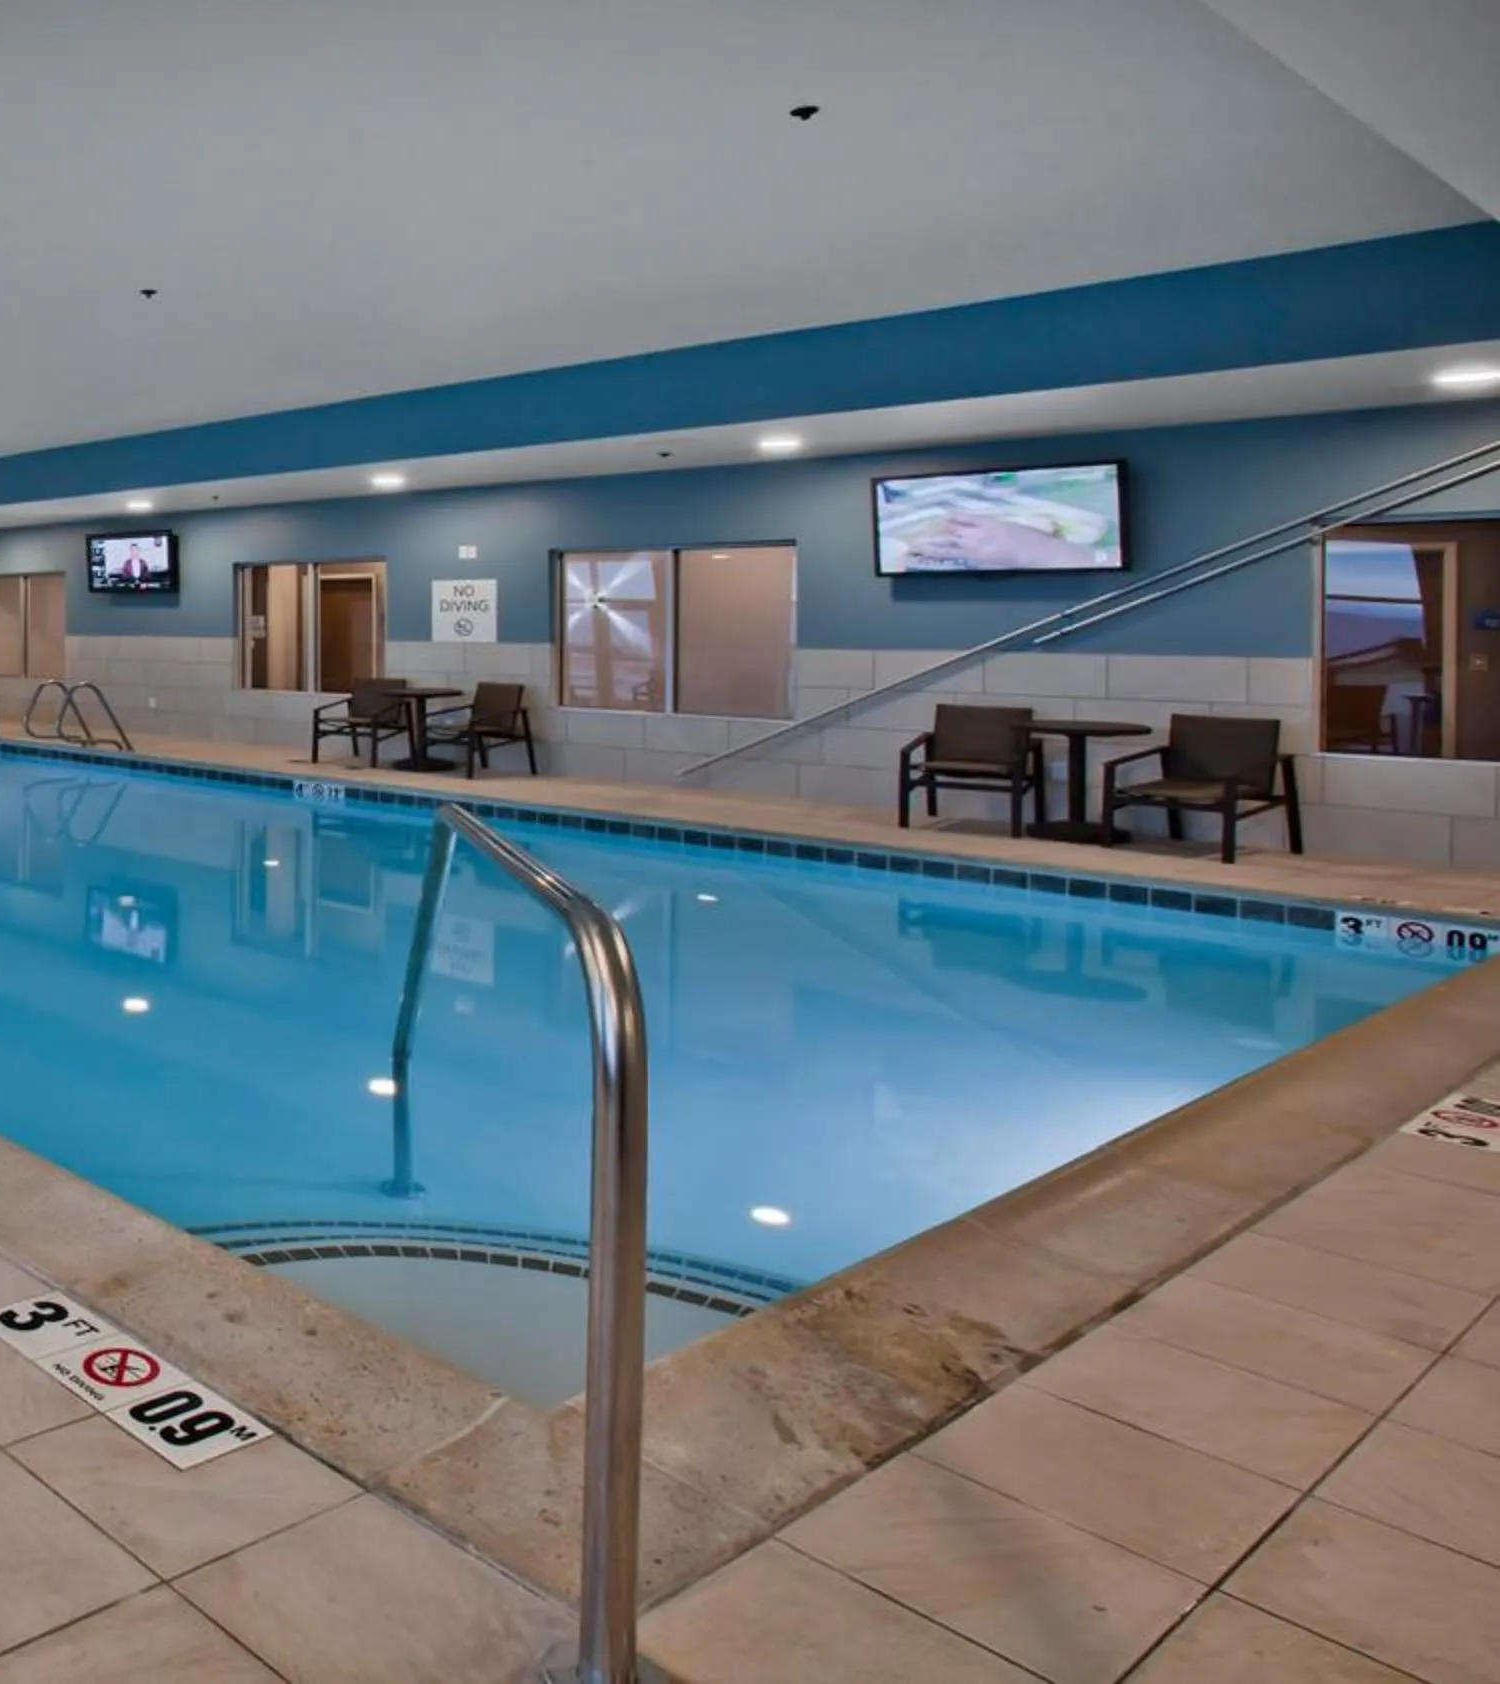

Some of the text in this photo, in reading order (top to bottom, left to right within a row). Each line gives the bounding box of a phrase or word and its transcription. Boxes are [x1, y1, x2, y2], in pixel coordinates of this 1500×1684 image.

[453, 584, 475, 597] NO
[440, 599, 489, 613] DIVING
[62, 1318, 101, 1337] FT
[52, 1363, 104, 1401] NO DIVING
[129, 1391, 258, 1446] 0.9 M
